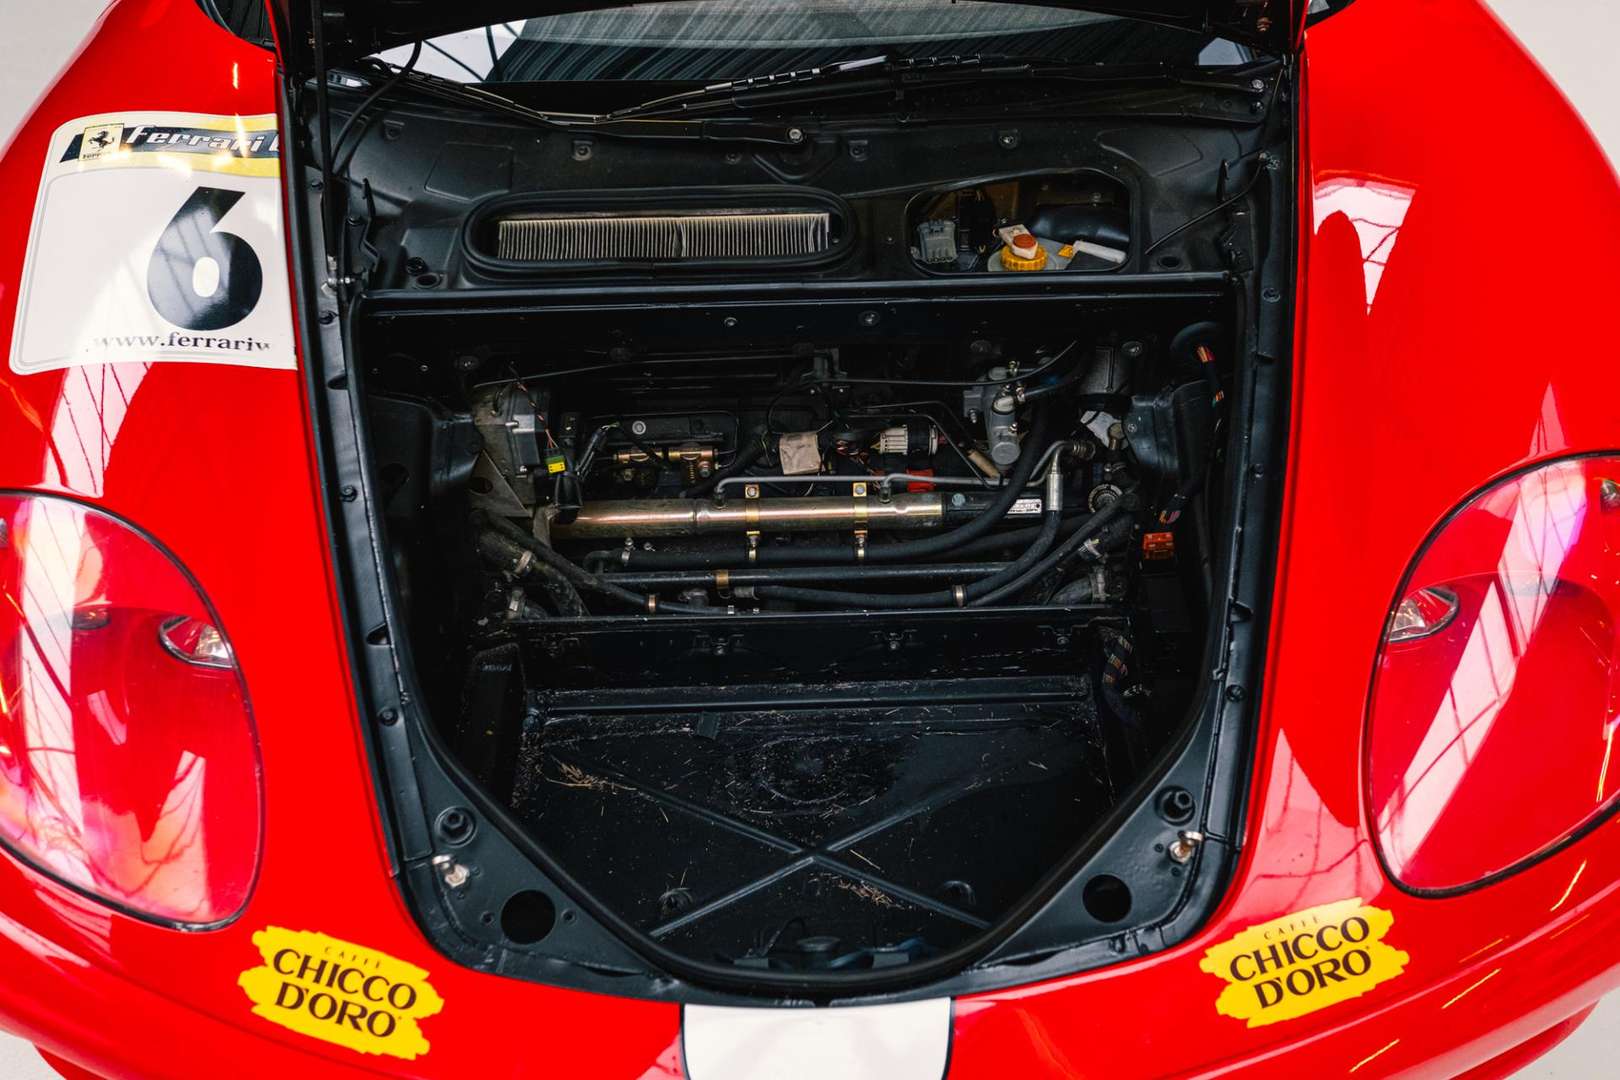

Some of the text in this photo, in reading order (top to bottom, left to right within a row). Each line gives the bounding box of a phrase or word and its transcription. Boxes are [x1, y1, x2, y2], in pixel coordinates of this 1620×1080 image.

[126, 125, 265, 152] Ferrari
[147, 186, 263, 331] 6
[273, 948, 417, 1010] CHICCO
[1230, 917, 1370, 981] CHICCO
[1254, 949, 1371, 1009] D'ORO
[275, 981, 396, 1037] D'ORO
